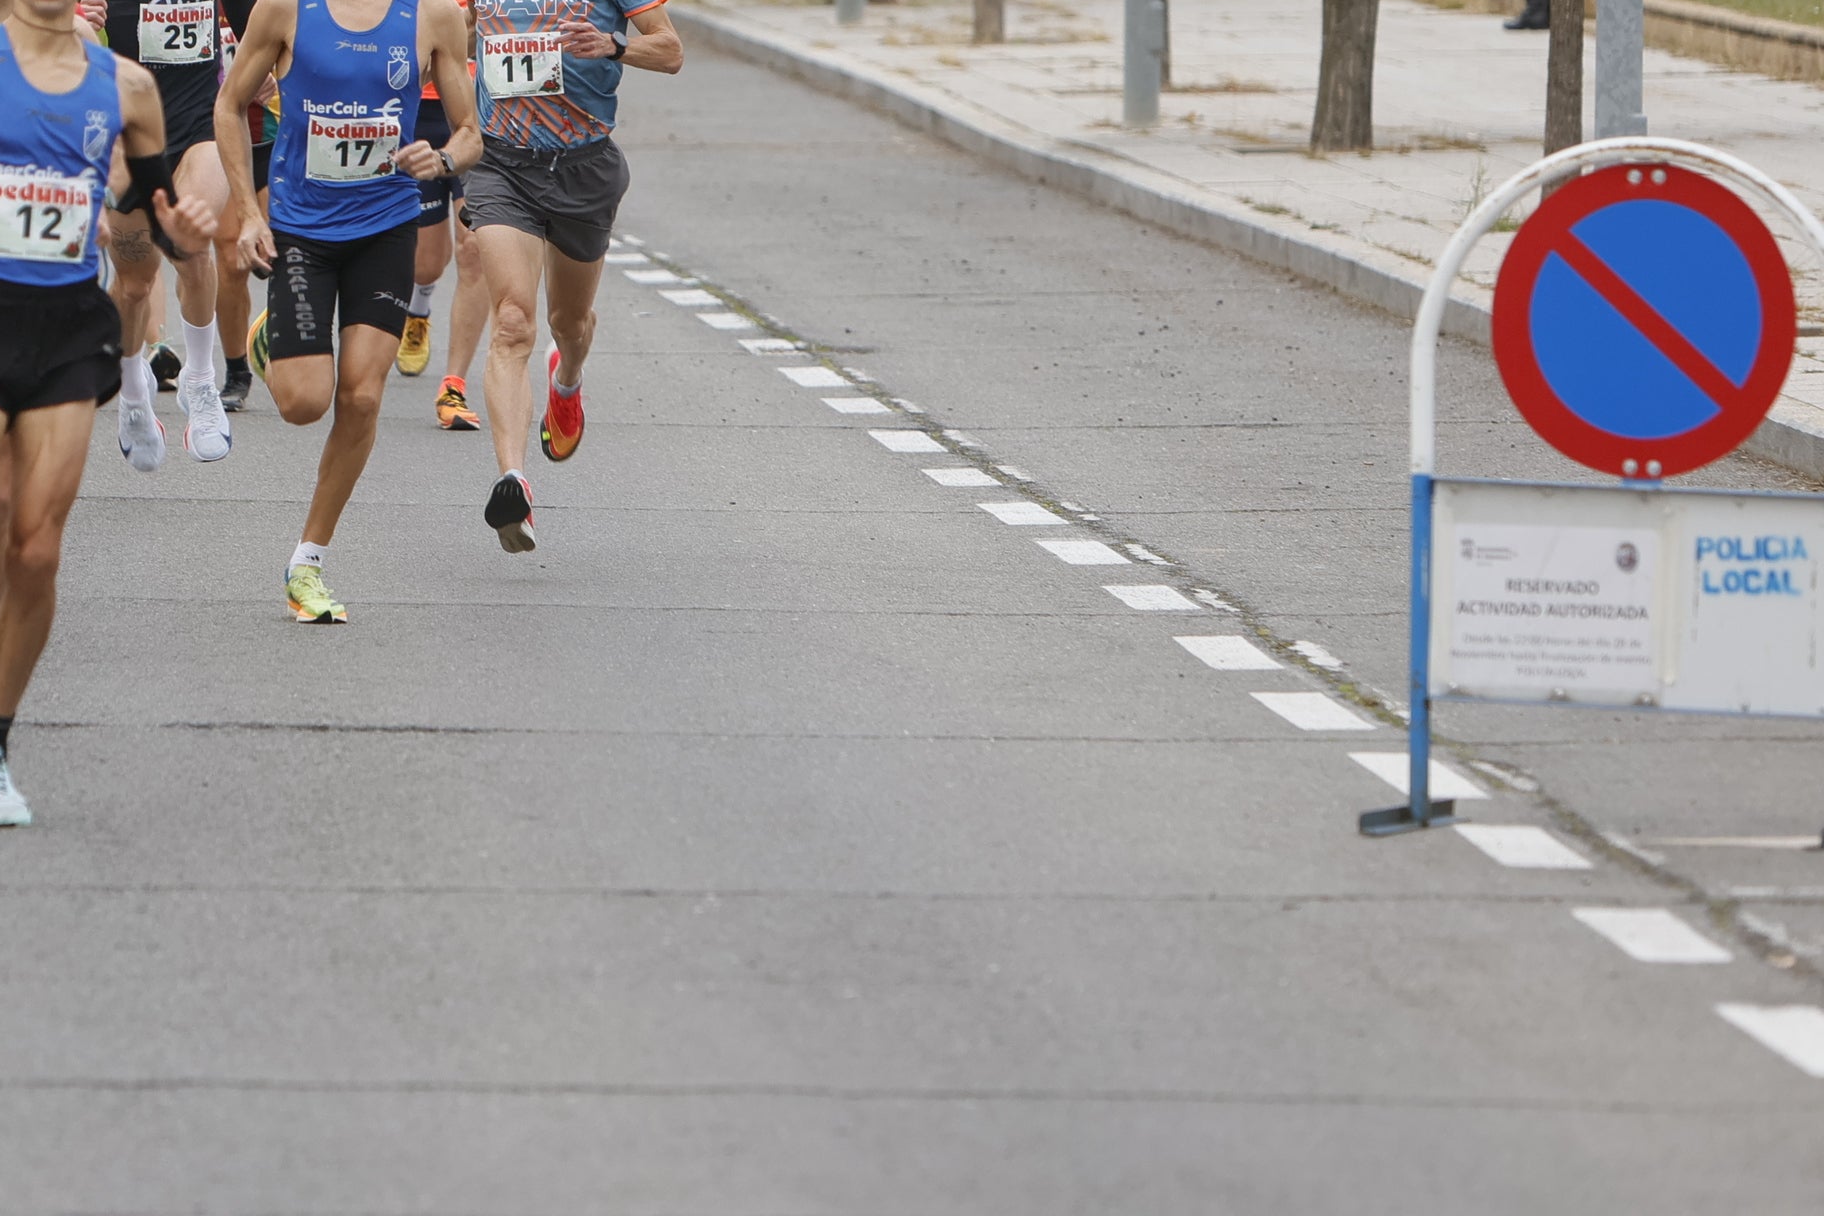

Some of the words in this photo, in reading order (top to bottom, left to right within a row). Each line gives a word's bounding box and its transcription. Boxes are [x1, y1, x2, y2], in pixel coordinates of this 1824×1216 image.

[143, 6, 213, 23] bedunia
[164, 24, 197, 50] 25
[502, 55, 534, 82] 11
[303, 99, 368, 118] iberCaja
[311, 120, 399, 139] bedunia
[335, 140, 376, 167] 17
[16, 204, 63, 241] 12
[1696, 536, 1808, 562] POLICIA
[1504, 578, 1600, 597] RESERVADO
[1702, 569, 1802, 596] LOCAL
[1456, 599, 1542, 618] ACTIVIDAD
[1545, 602, 1650, 621] AUTORIZADA
